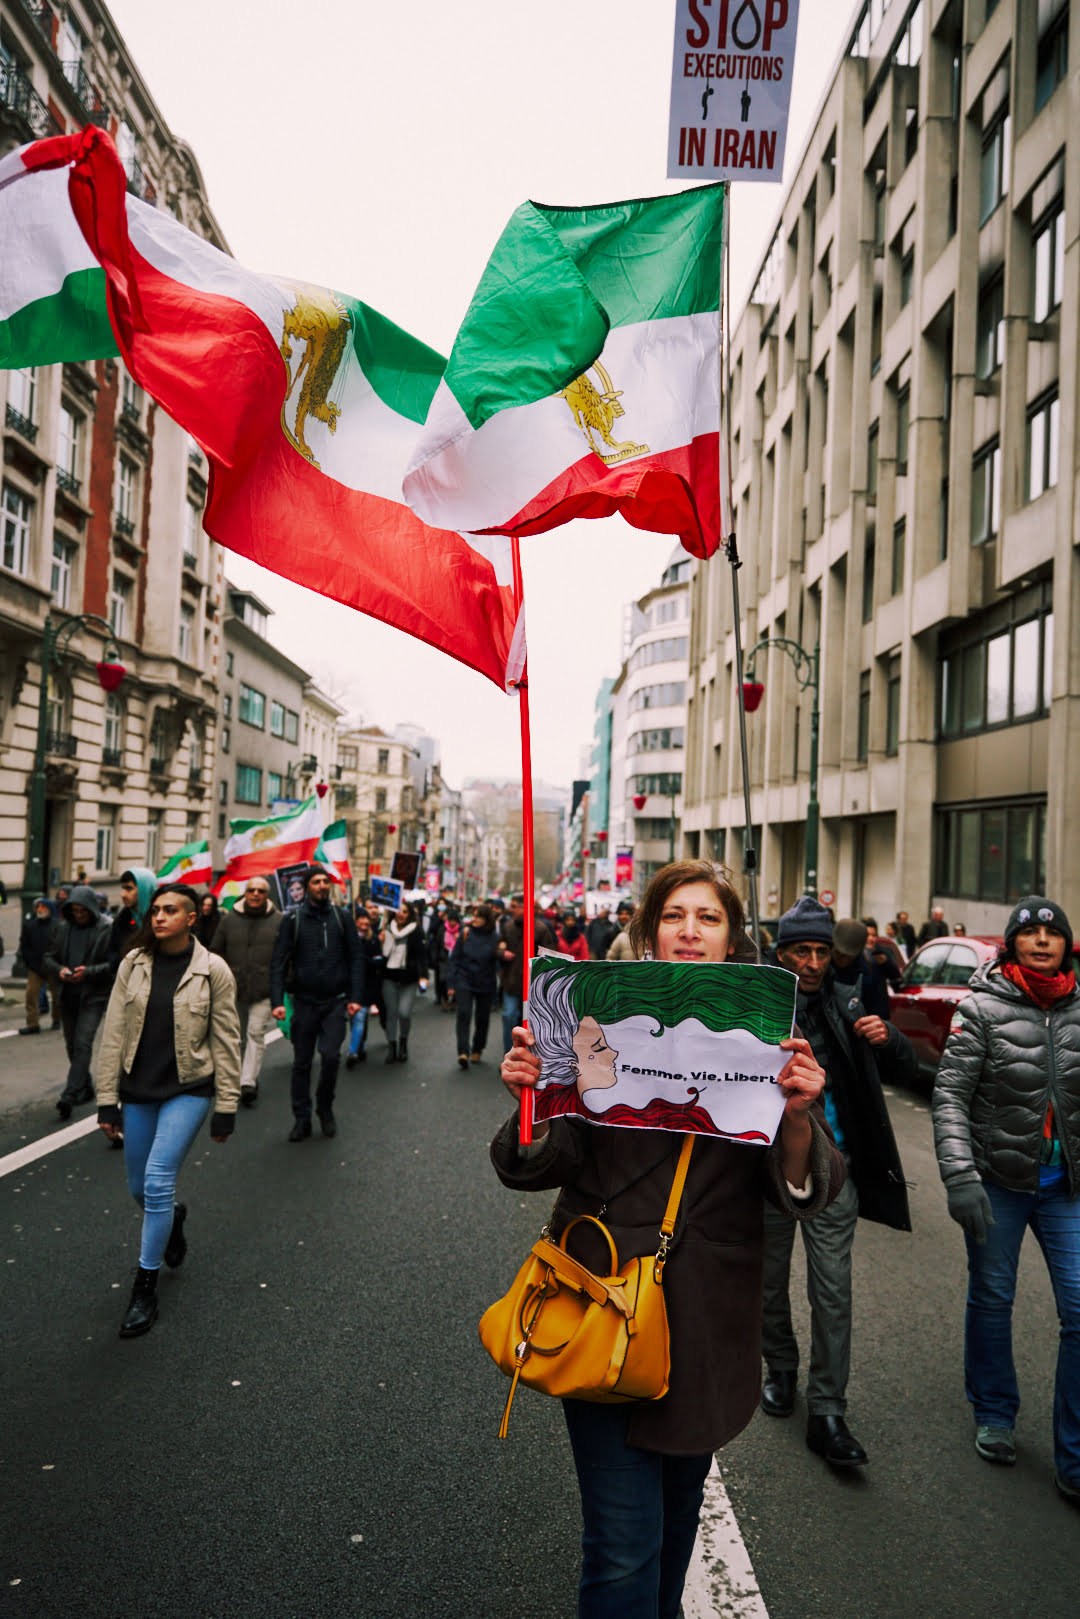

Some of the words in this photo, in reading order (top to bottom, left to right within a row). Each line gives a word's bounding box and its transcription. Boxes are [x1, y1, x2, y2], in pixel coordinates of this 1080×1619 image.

[686, 0, 789, 51] STOP
[684, 53, 784, 81] EXECUTIONS
[678, 127, 706, 167] IN
[714, 128, 777, 170] IRAN
[621, 1064, 688, 1081] Femme,
[690, 1071, 722, 1082] Vie,
[724, 1072, 778, 1085] Libert
